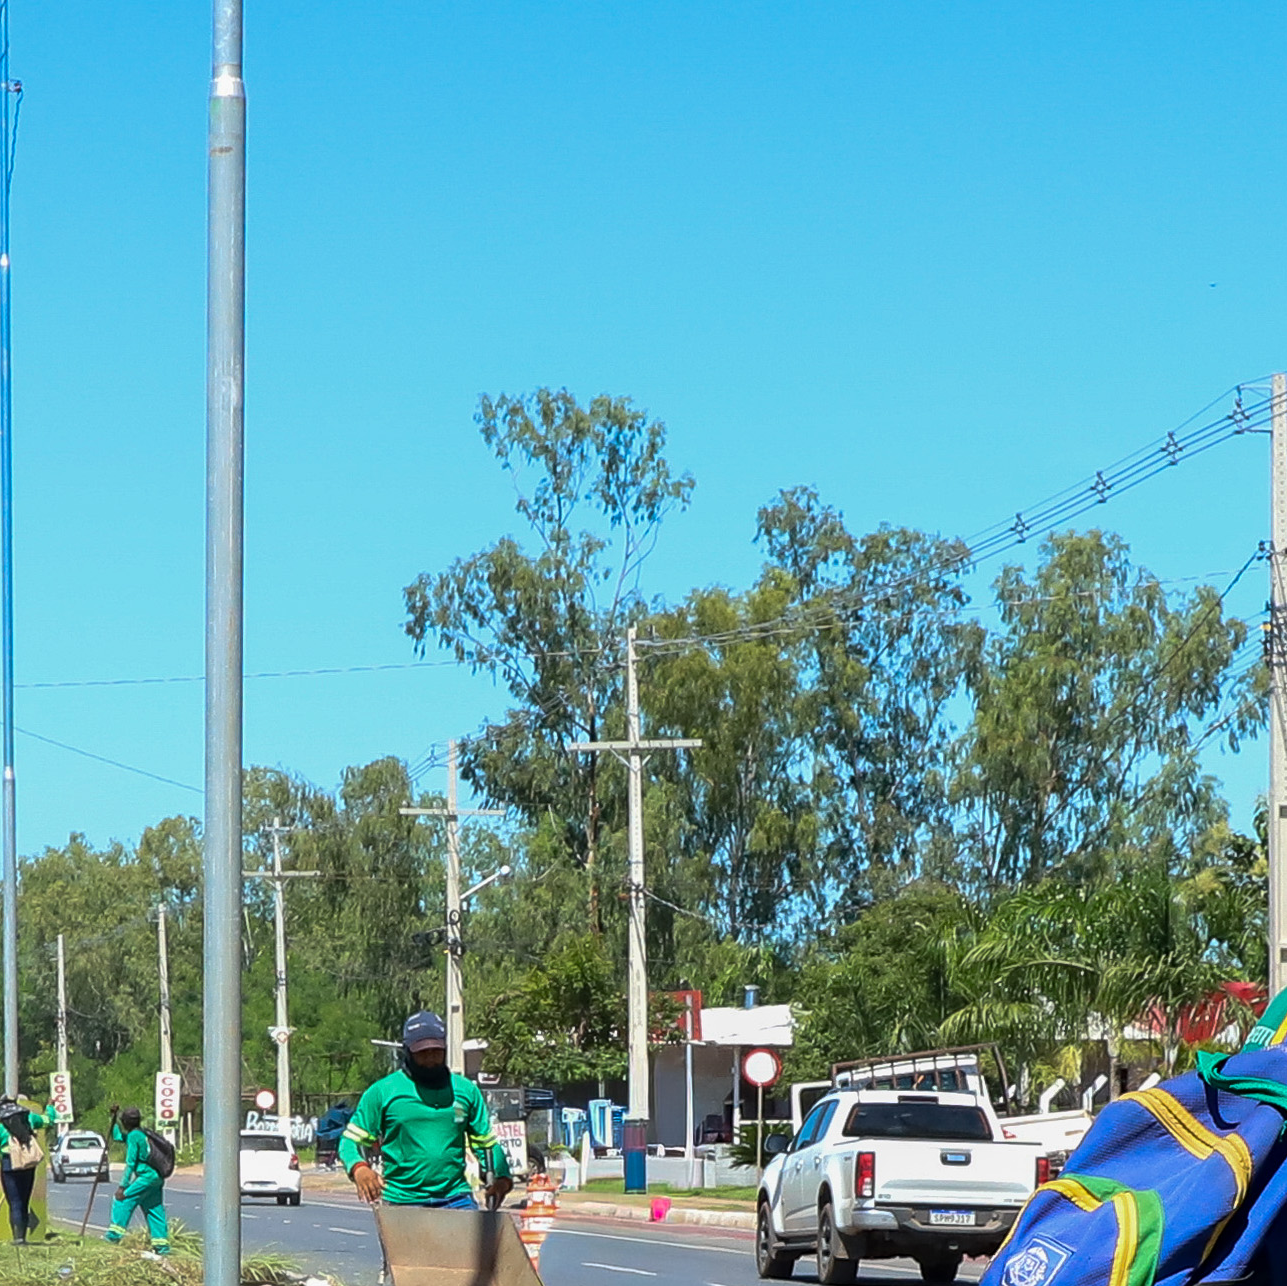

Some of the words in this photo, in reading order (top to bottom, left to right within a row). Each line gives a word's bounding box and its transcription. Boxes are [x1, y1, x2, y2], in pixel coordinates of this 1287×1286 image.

[54, 1074, 67, 1113] COCO
[160, 1077, 174, 1119] COCO
[493, 1123, 525, 1137] ASTEL
